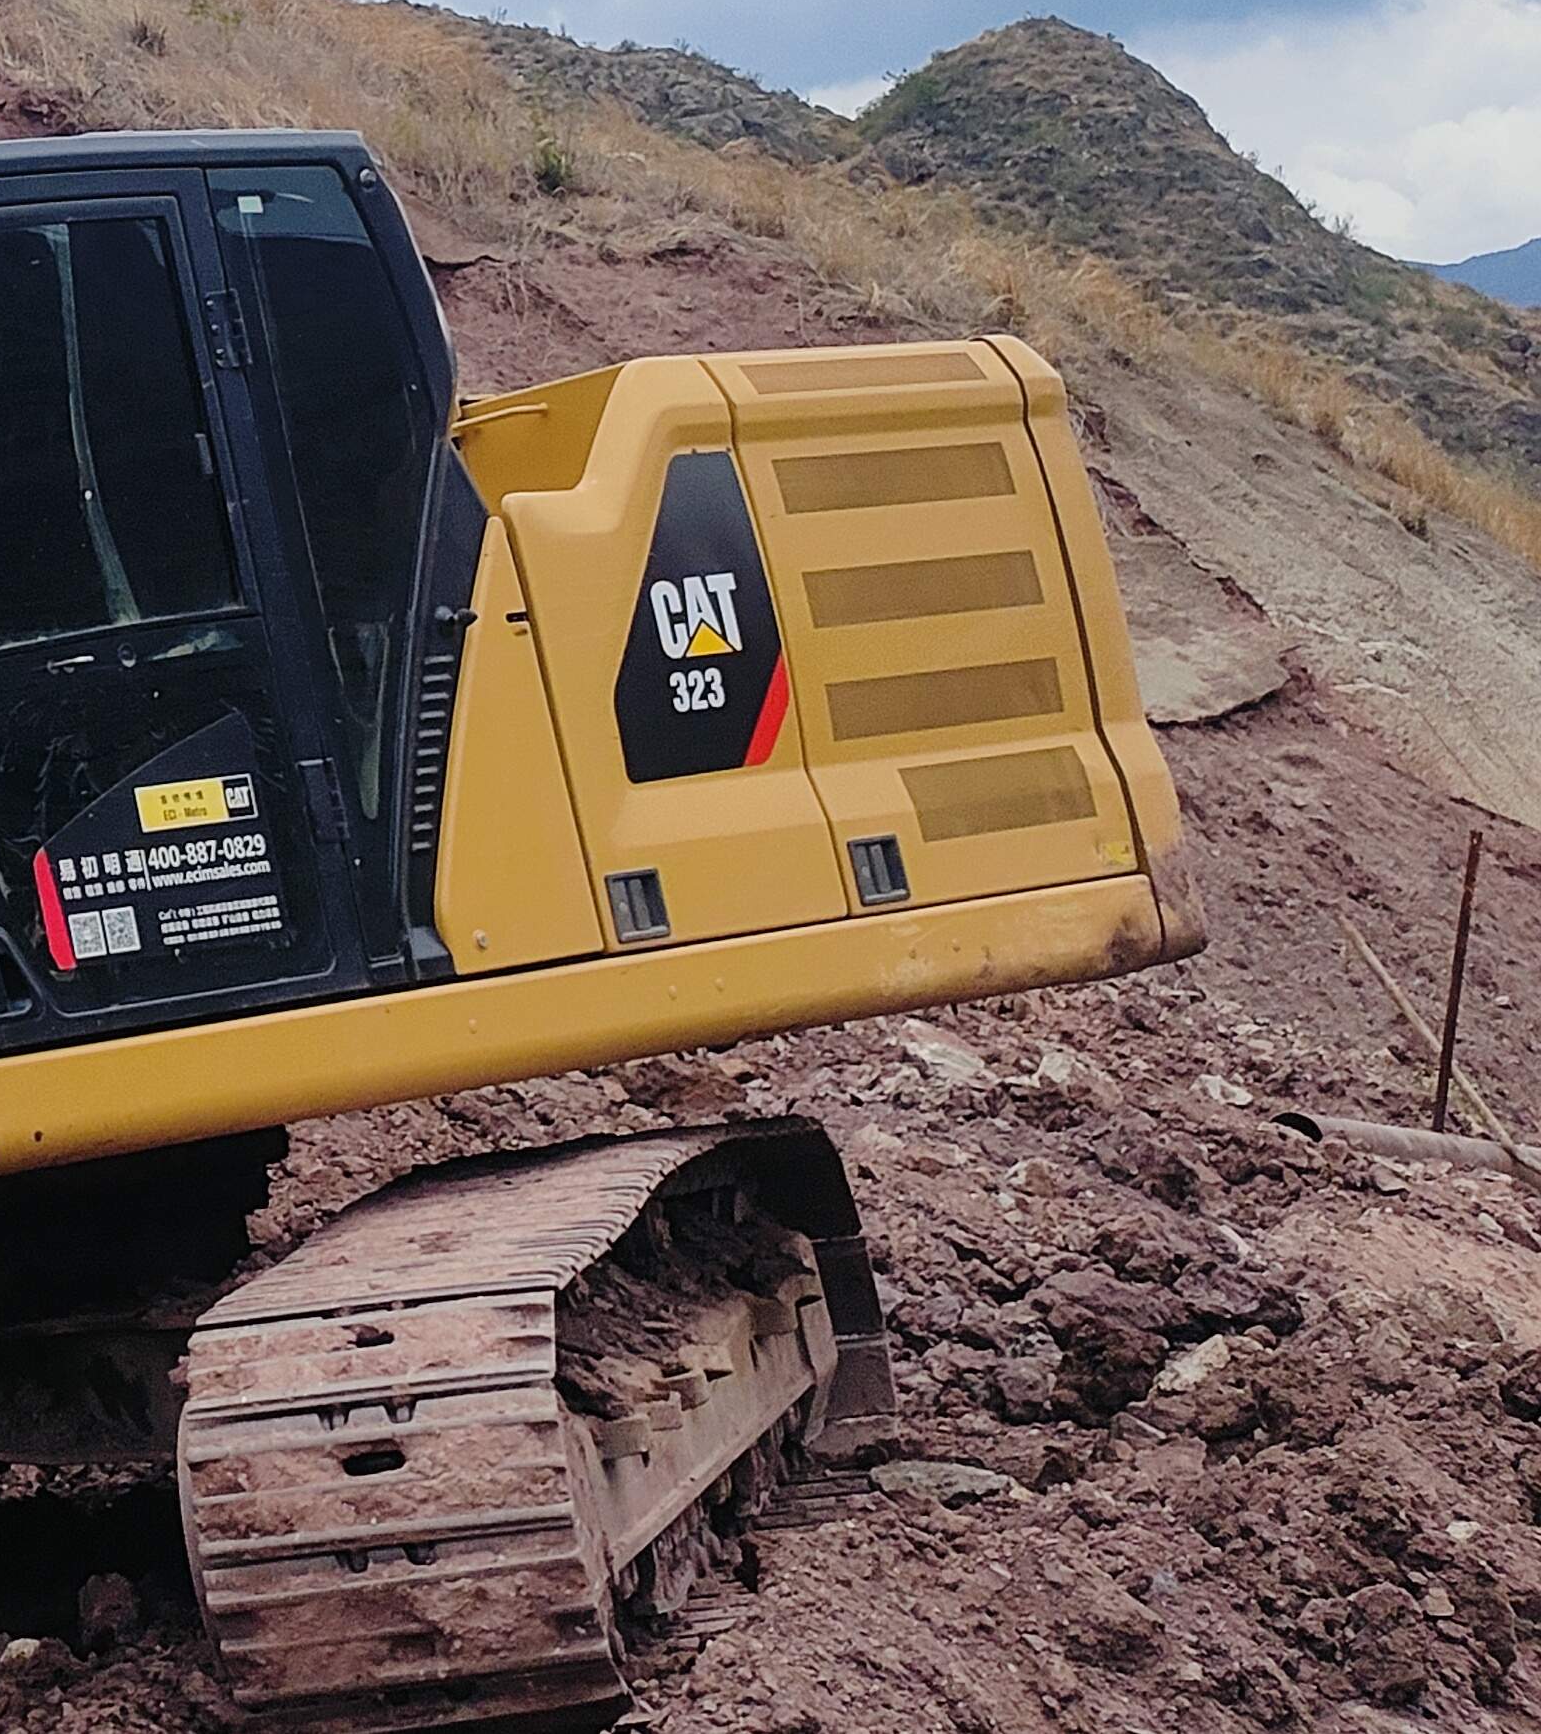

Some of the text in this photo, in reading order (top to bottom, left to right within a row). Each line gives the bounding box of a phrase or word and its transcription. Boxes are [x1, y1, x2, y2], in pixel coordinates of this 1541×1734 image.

[650, 572, 743, 659] CAT
[669, 667, 726, 712] 323
[225, 786, 250, 809] CAT
[148, 834, 266, 870] 400-887-0829
[152, 860, 271, 888] www.ecimsales.com
